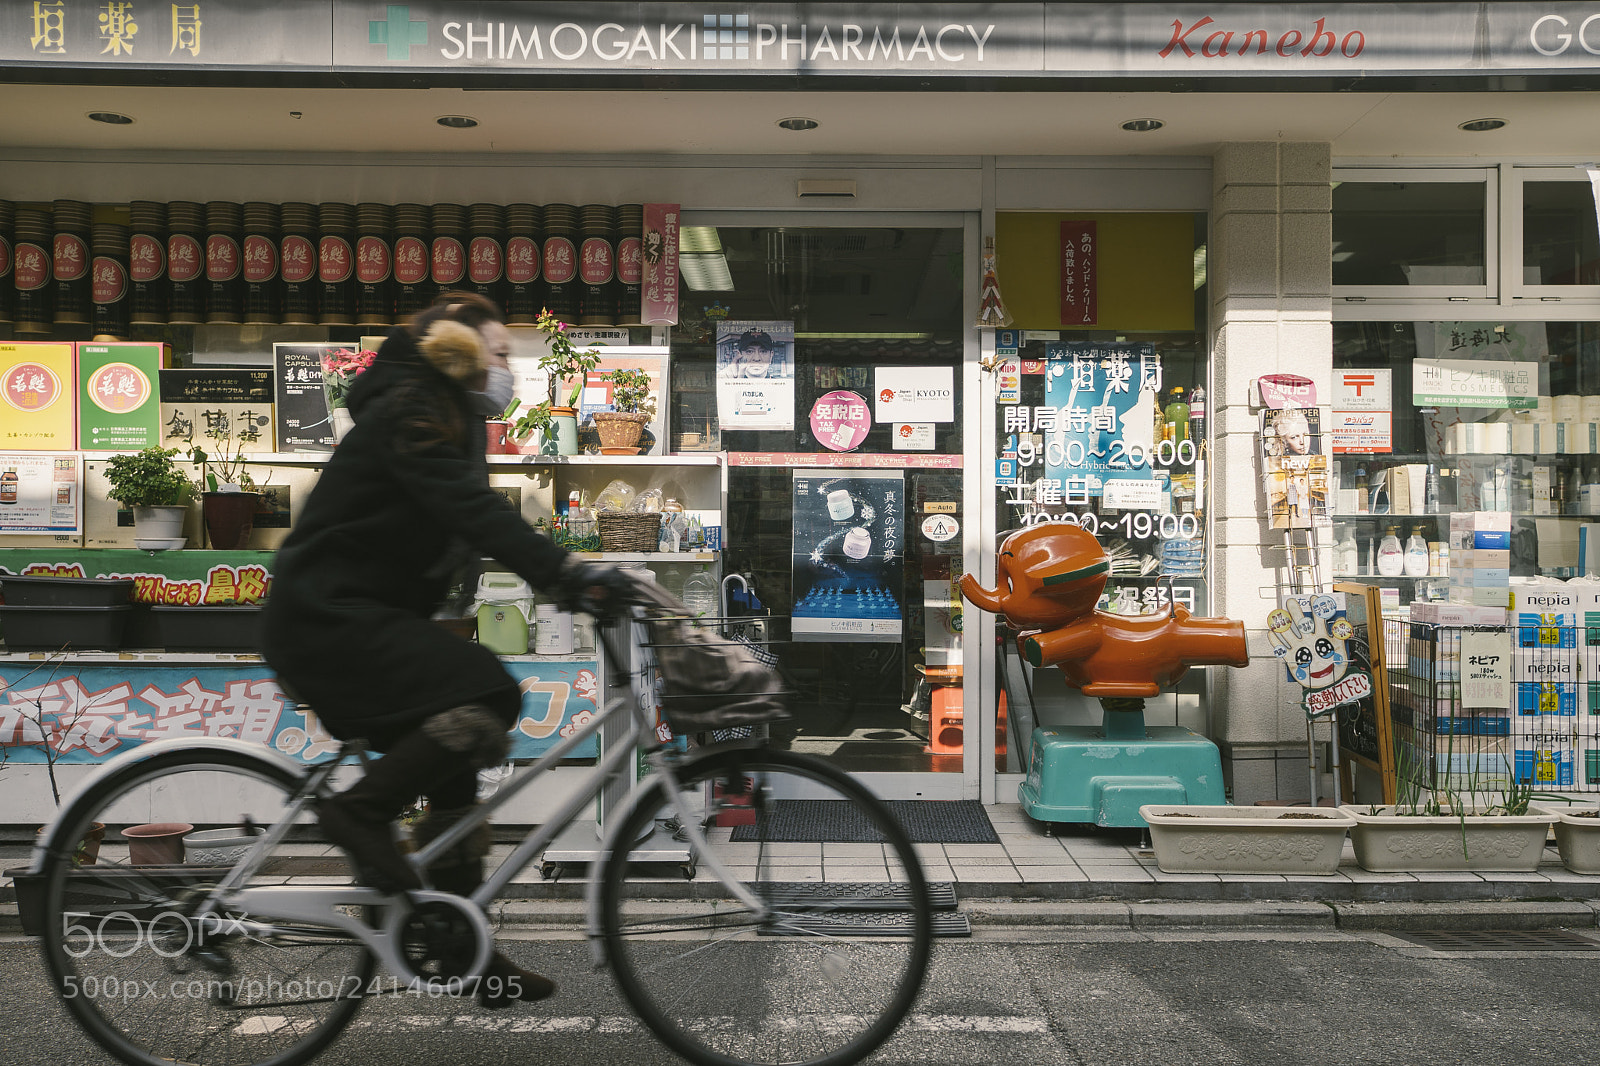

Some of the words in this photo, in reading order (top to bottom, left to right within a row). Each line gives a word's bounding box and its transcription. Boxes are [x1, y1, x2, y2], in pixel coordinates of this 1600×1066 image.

[30, 1, 202, 57] 垣薬局
[1158, 16, 1365, 59] Kanebo
[441, 22, 697, 61] SHIMOGAKI
[756, 24, 995, 61] PHARMACY
[1065, 240, 1075, 306] 入荷致しました。
[1081, 232, 1092, 322] あの、ハンド・クリーム
[1450, 369, 1528, 384] ヒノキ肌粧品
[1450, 384, 1528, 393] COSMEDICS
[816, 404, 864, 420] 免税店
[1004, 406, 1116, 433] 開局時間
[1080, 460, 1111, 472] Hybri
[1282, 456, 1315, 469] news
[1006, 478, 1089, 505] 土曜日
[884, 490, 898, 566] 真冬の夜の夢。
[1114, 586, 1195, 614] 祝祭日
[1528, 595, 1570, 606] nepia
[1540, 613, 1556, 625] 1.5
[1469, 656, 1499, 665] ネピア
[1528, 663, 1570, 677] nepia
[1308, 674, 1368, 713] 感動して下さい
[1526, 731, 1568, 744] nepia
